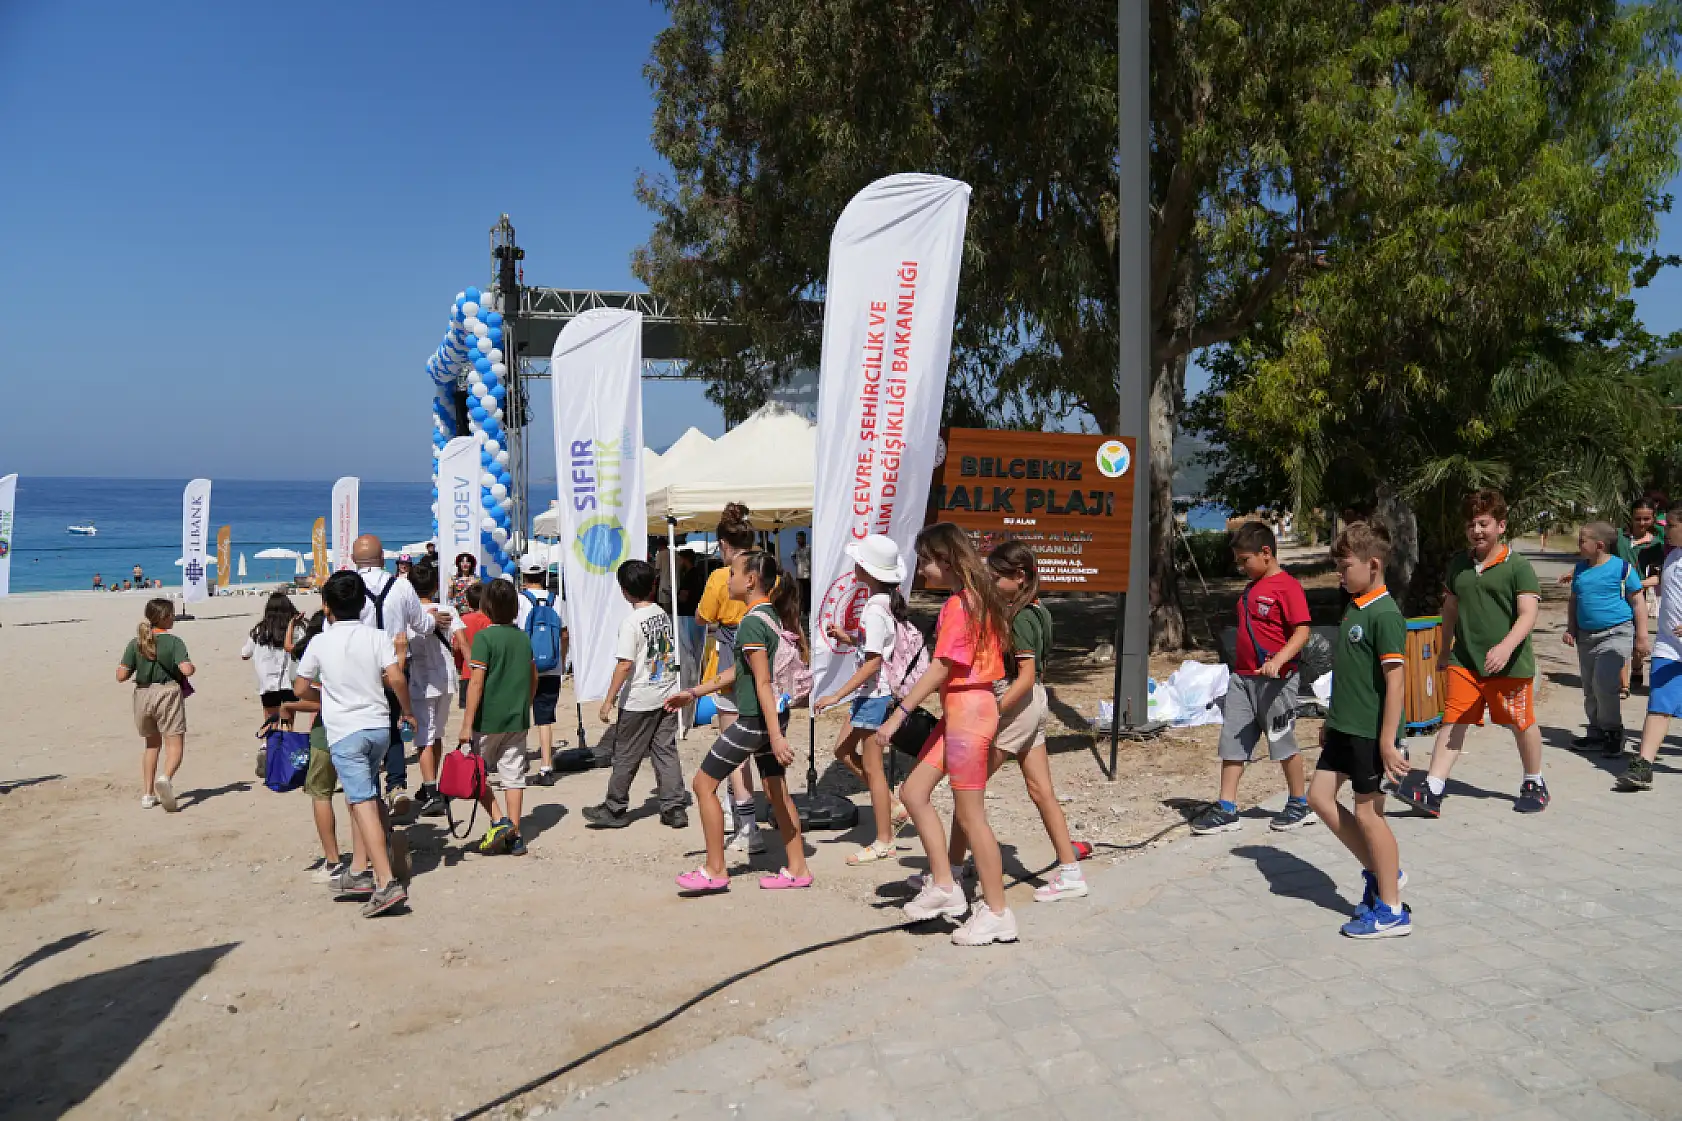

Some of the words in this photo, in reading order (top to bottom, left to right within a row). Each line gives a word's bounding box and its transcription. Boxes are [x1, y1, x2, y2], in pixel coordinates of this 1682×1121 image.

[869, 301, 887, 326] VE
[891, 260, 919, 372] BAKANLIĞI
[860, 332, 885, 442] ŞEHİRCİLİK
[595, 438, 623, 508] ATIK
[880, 378, 907, 498] DEĞİŞİKLİĞİ
[571, 438, 597, 511] SIFIR
[853, 447, 877, 516] ÇEVRE,
[875, 503, 894, 535] LİM
[1030, 543, 1083, 555] AKANLIĞI
